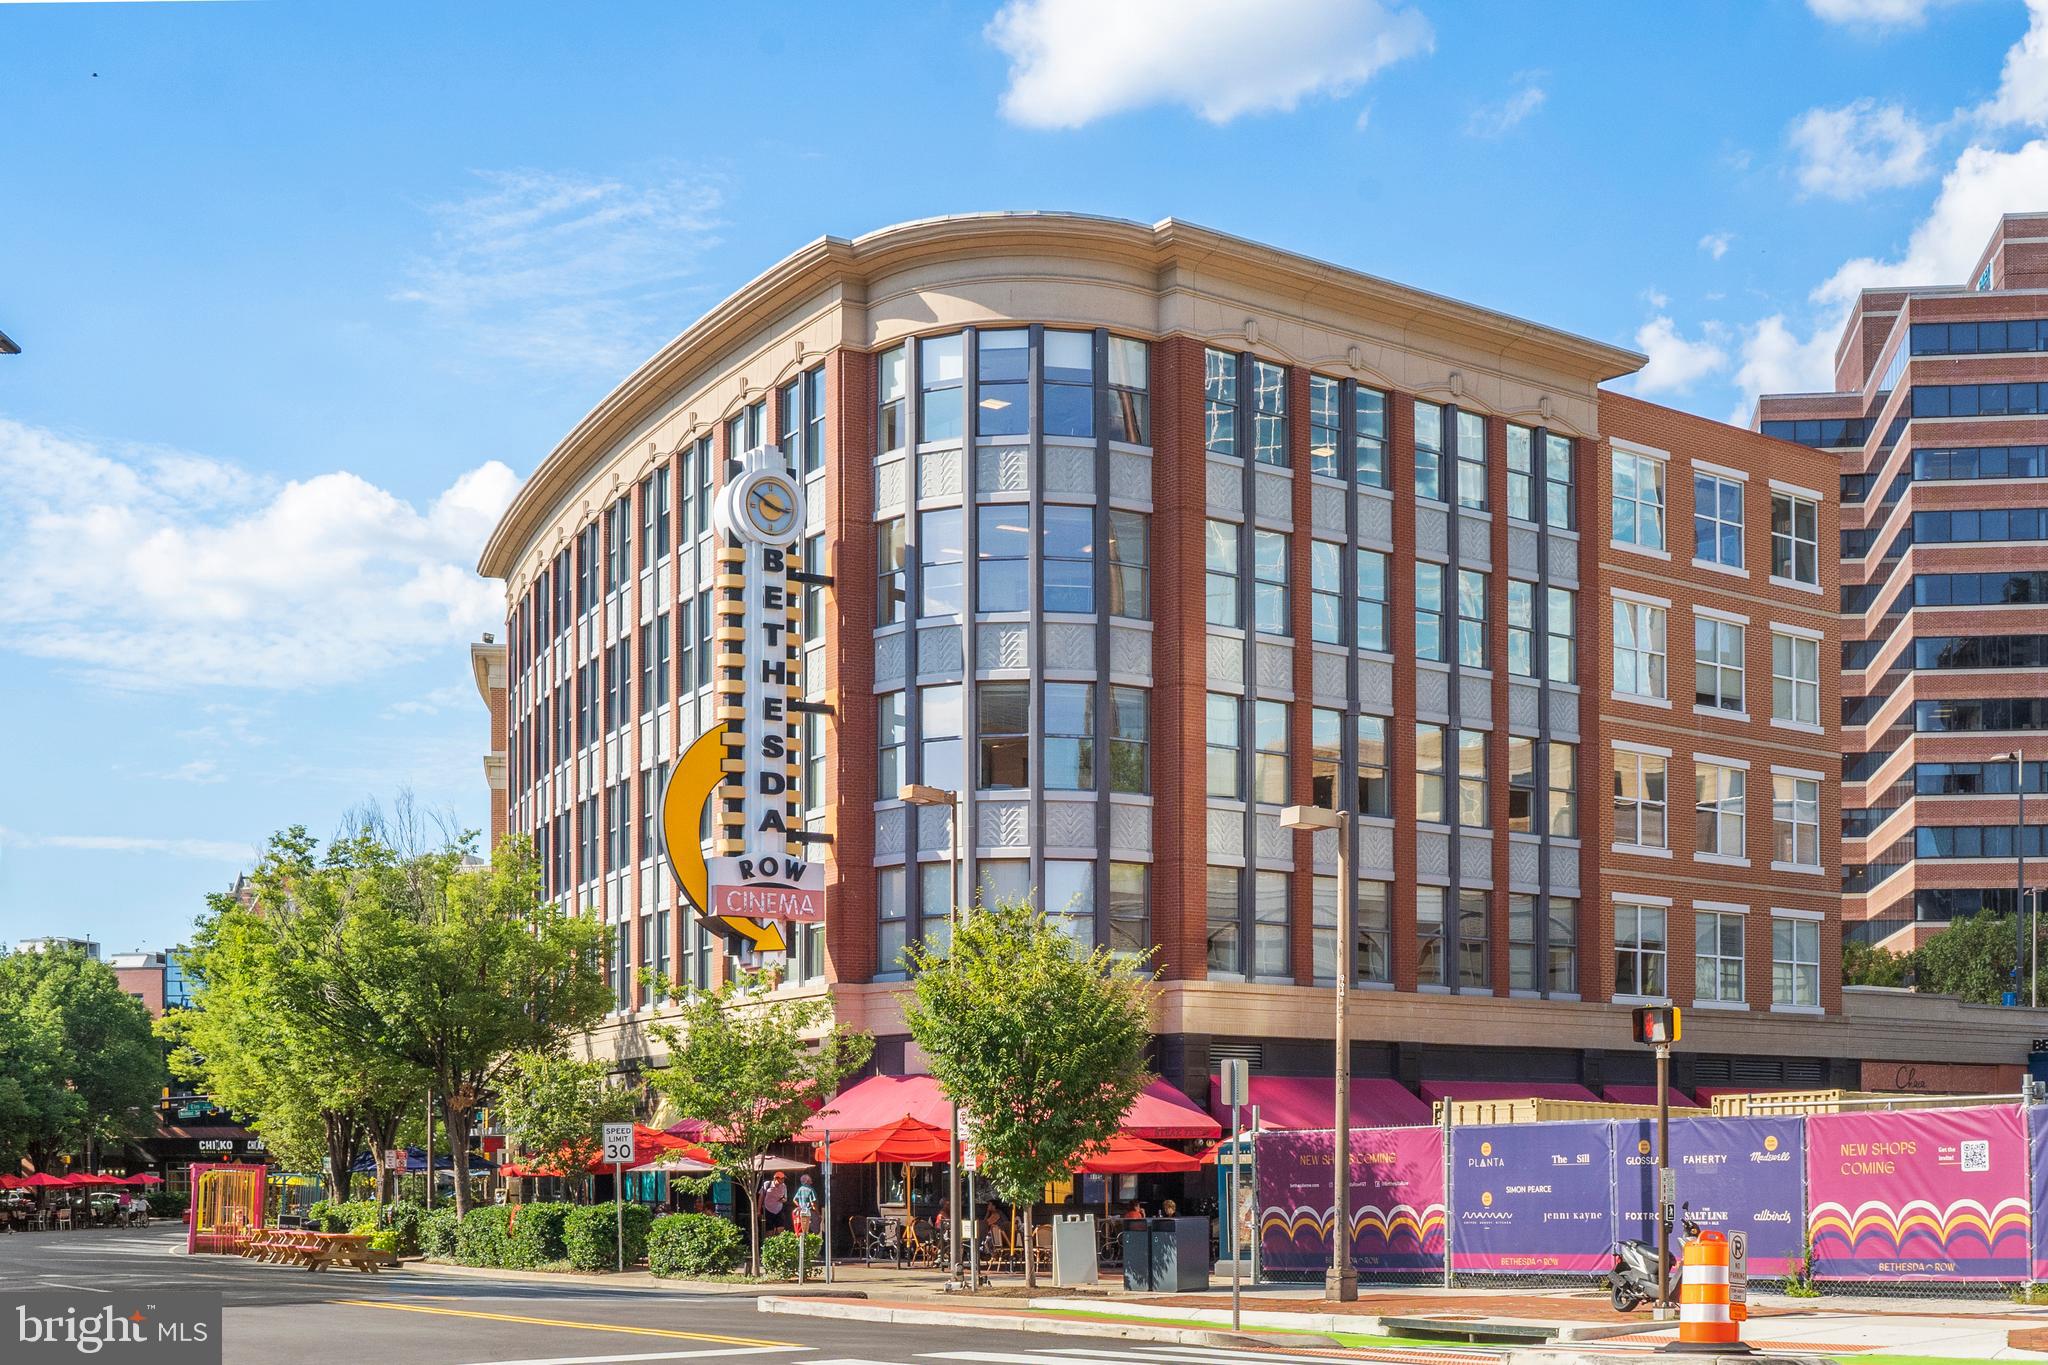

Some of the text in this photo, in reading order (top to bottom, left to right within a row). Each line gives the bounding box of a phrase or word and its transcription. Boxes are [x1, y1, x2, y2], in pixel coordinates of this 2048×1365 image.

[758, 548, 787, 833] BETHESDA
[739, 857, 807, 882] ROW
[727, 890, 816, 916] CINEMA
[606, 1127, 631, 1135] SPEED
[608, 1144, 631, 1159] 30
[1841, 1142, 1917, 1156] NEW SHOPS
[1300, 1154, 1320, 1166] NEW
[1357, 1152, 1397, 1165] COMING
[1551, 1153, 1590, 1164] The Sill
[1626, 1156, 1659, 1165] GLOSSLA
[1683, 1154, 1728, 1164] FAHERTY
[1749, 1151, 1791, 1164] Madewell
[1468, 1158, 1505, 1168] PLANTA
[1841, 1161, 1895, 1175] COMING
[1506, 1185, 1552, 1194] SIMON PEARCE
[1543, 1212, 1569, 1222] jenni
[1625, 1212, 1659, 1220] FOXTRO
[1684, 1211, 1729, 1220] SALT LINE
[1753, 1209, 1791, 1224] allbirds
[1501, 1257, 1559, 1266] BETHESDA ROW
[1878, 1262, 1956, 1272] BETHESDA ROW
